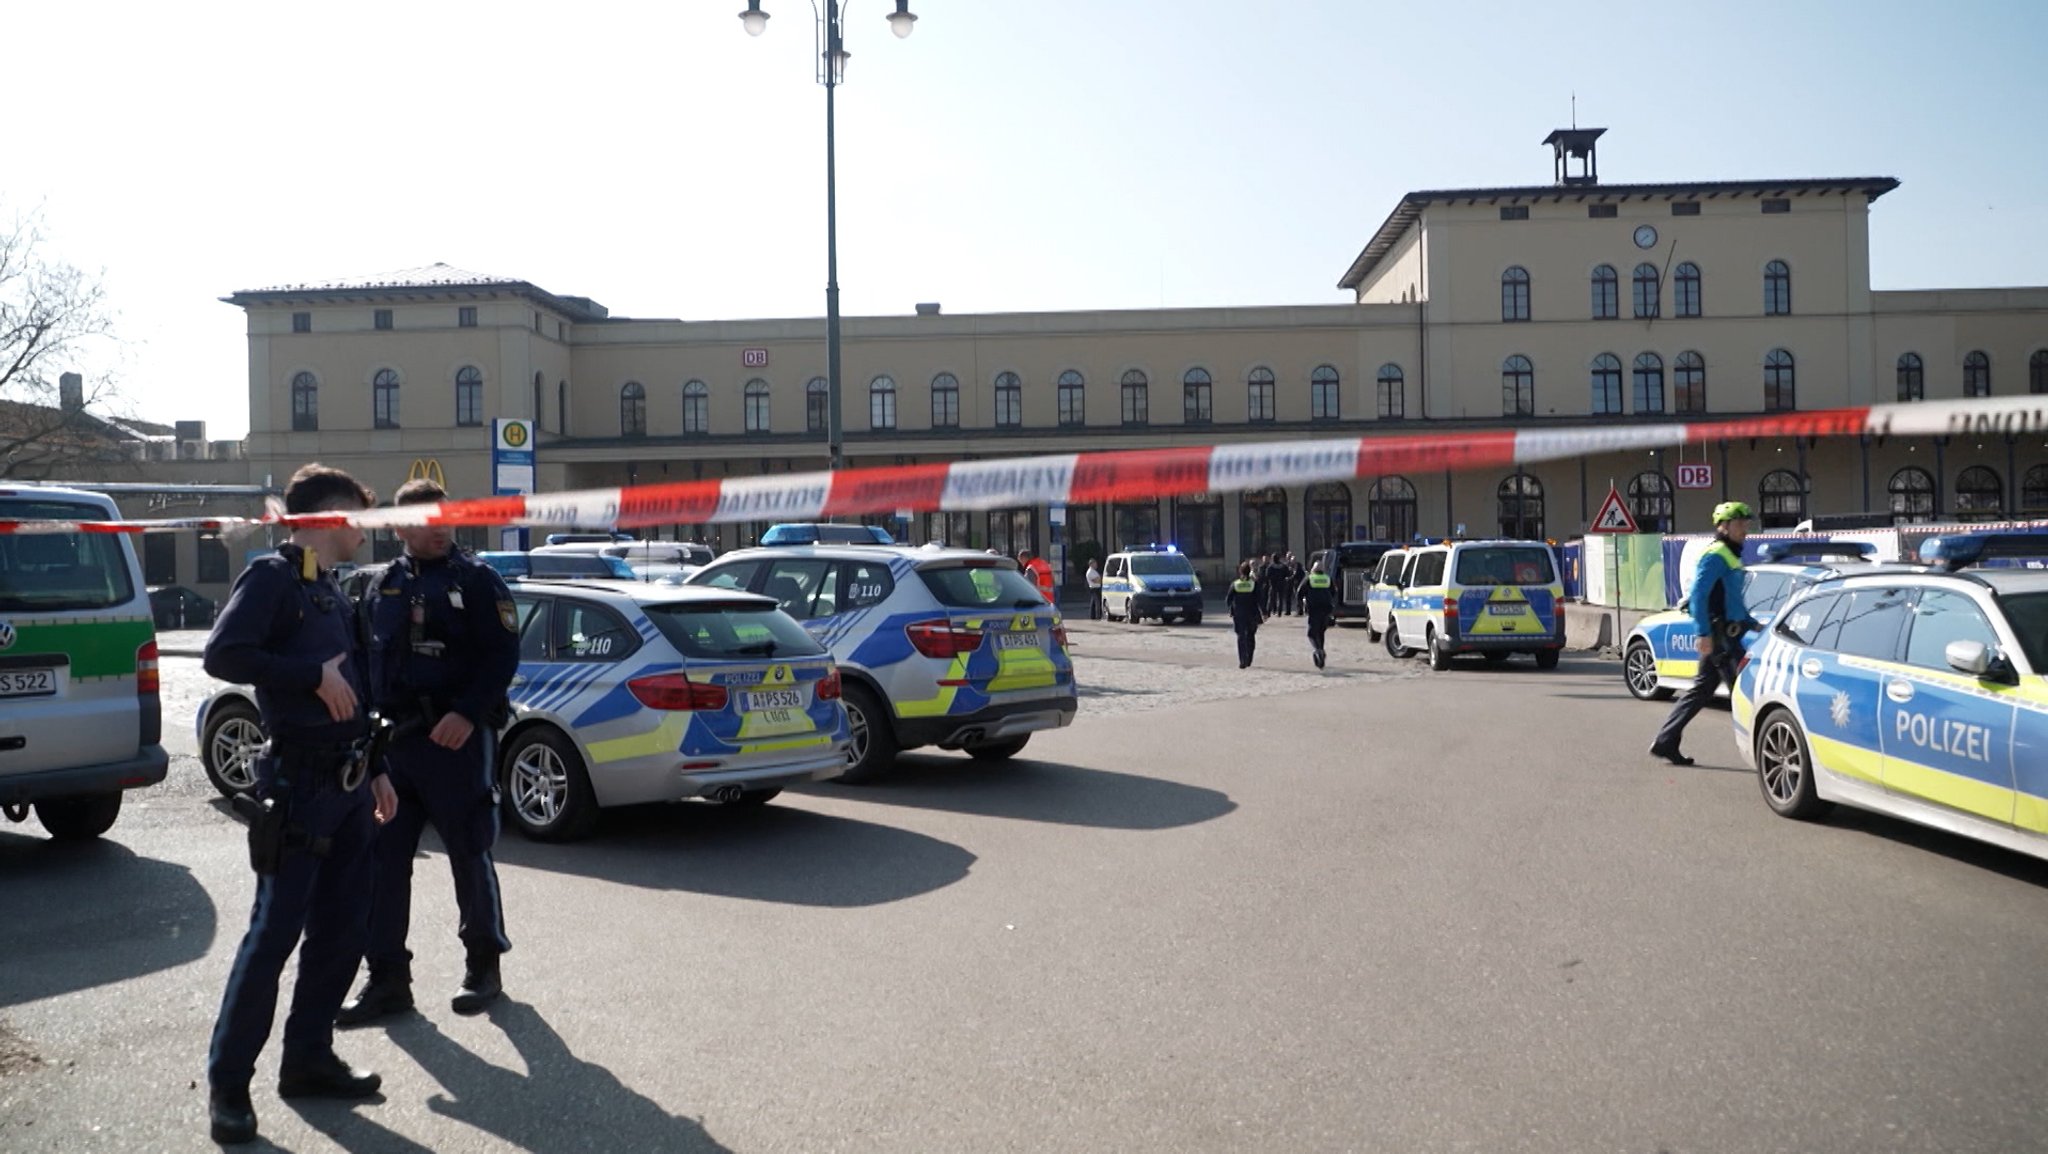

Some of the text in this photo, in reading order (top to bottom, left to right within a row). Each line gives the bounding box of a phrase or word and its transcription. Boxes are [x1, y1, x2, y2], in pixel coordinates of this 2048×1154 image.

[746, 352, 764, 364] DB
[510, 425, 521, 441] H
[1680, 467, 1710, 484] DB
[861, 584, 881, 597] 110
[588, 636, 612, 654] 110
[14, 672, 48, 691] 522
[753, 691, 800, 708] A PS 526
[1896, 709, 1991, 763] POLIZEI
